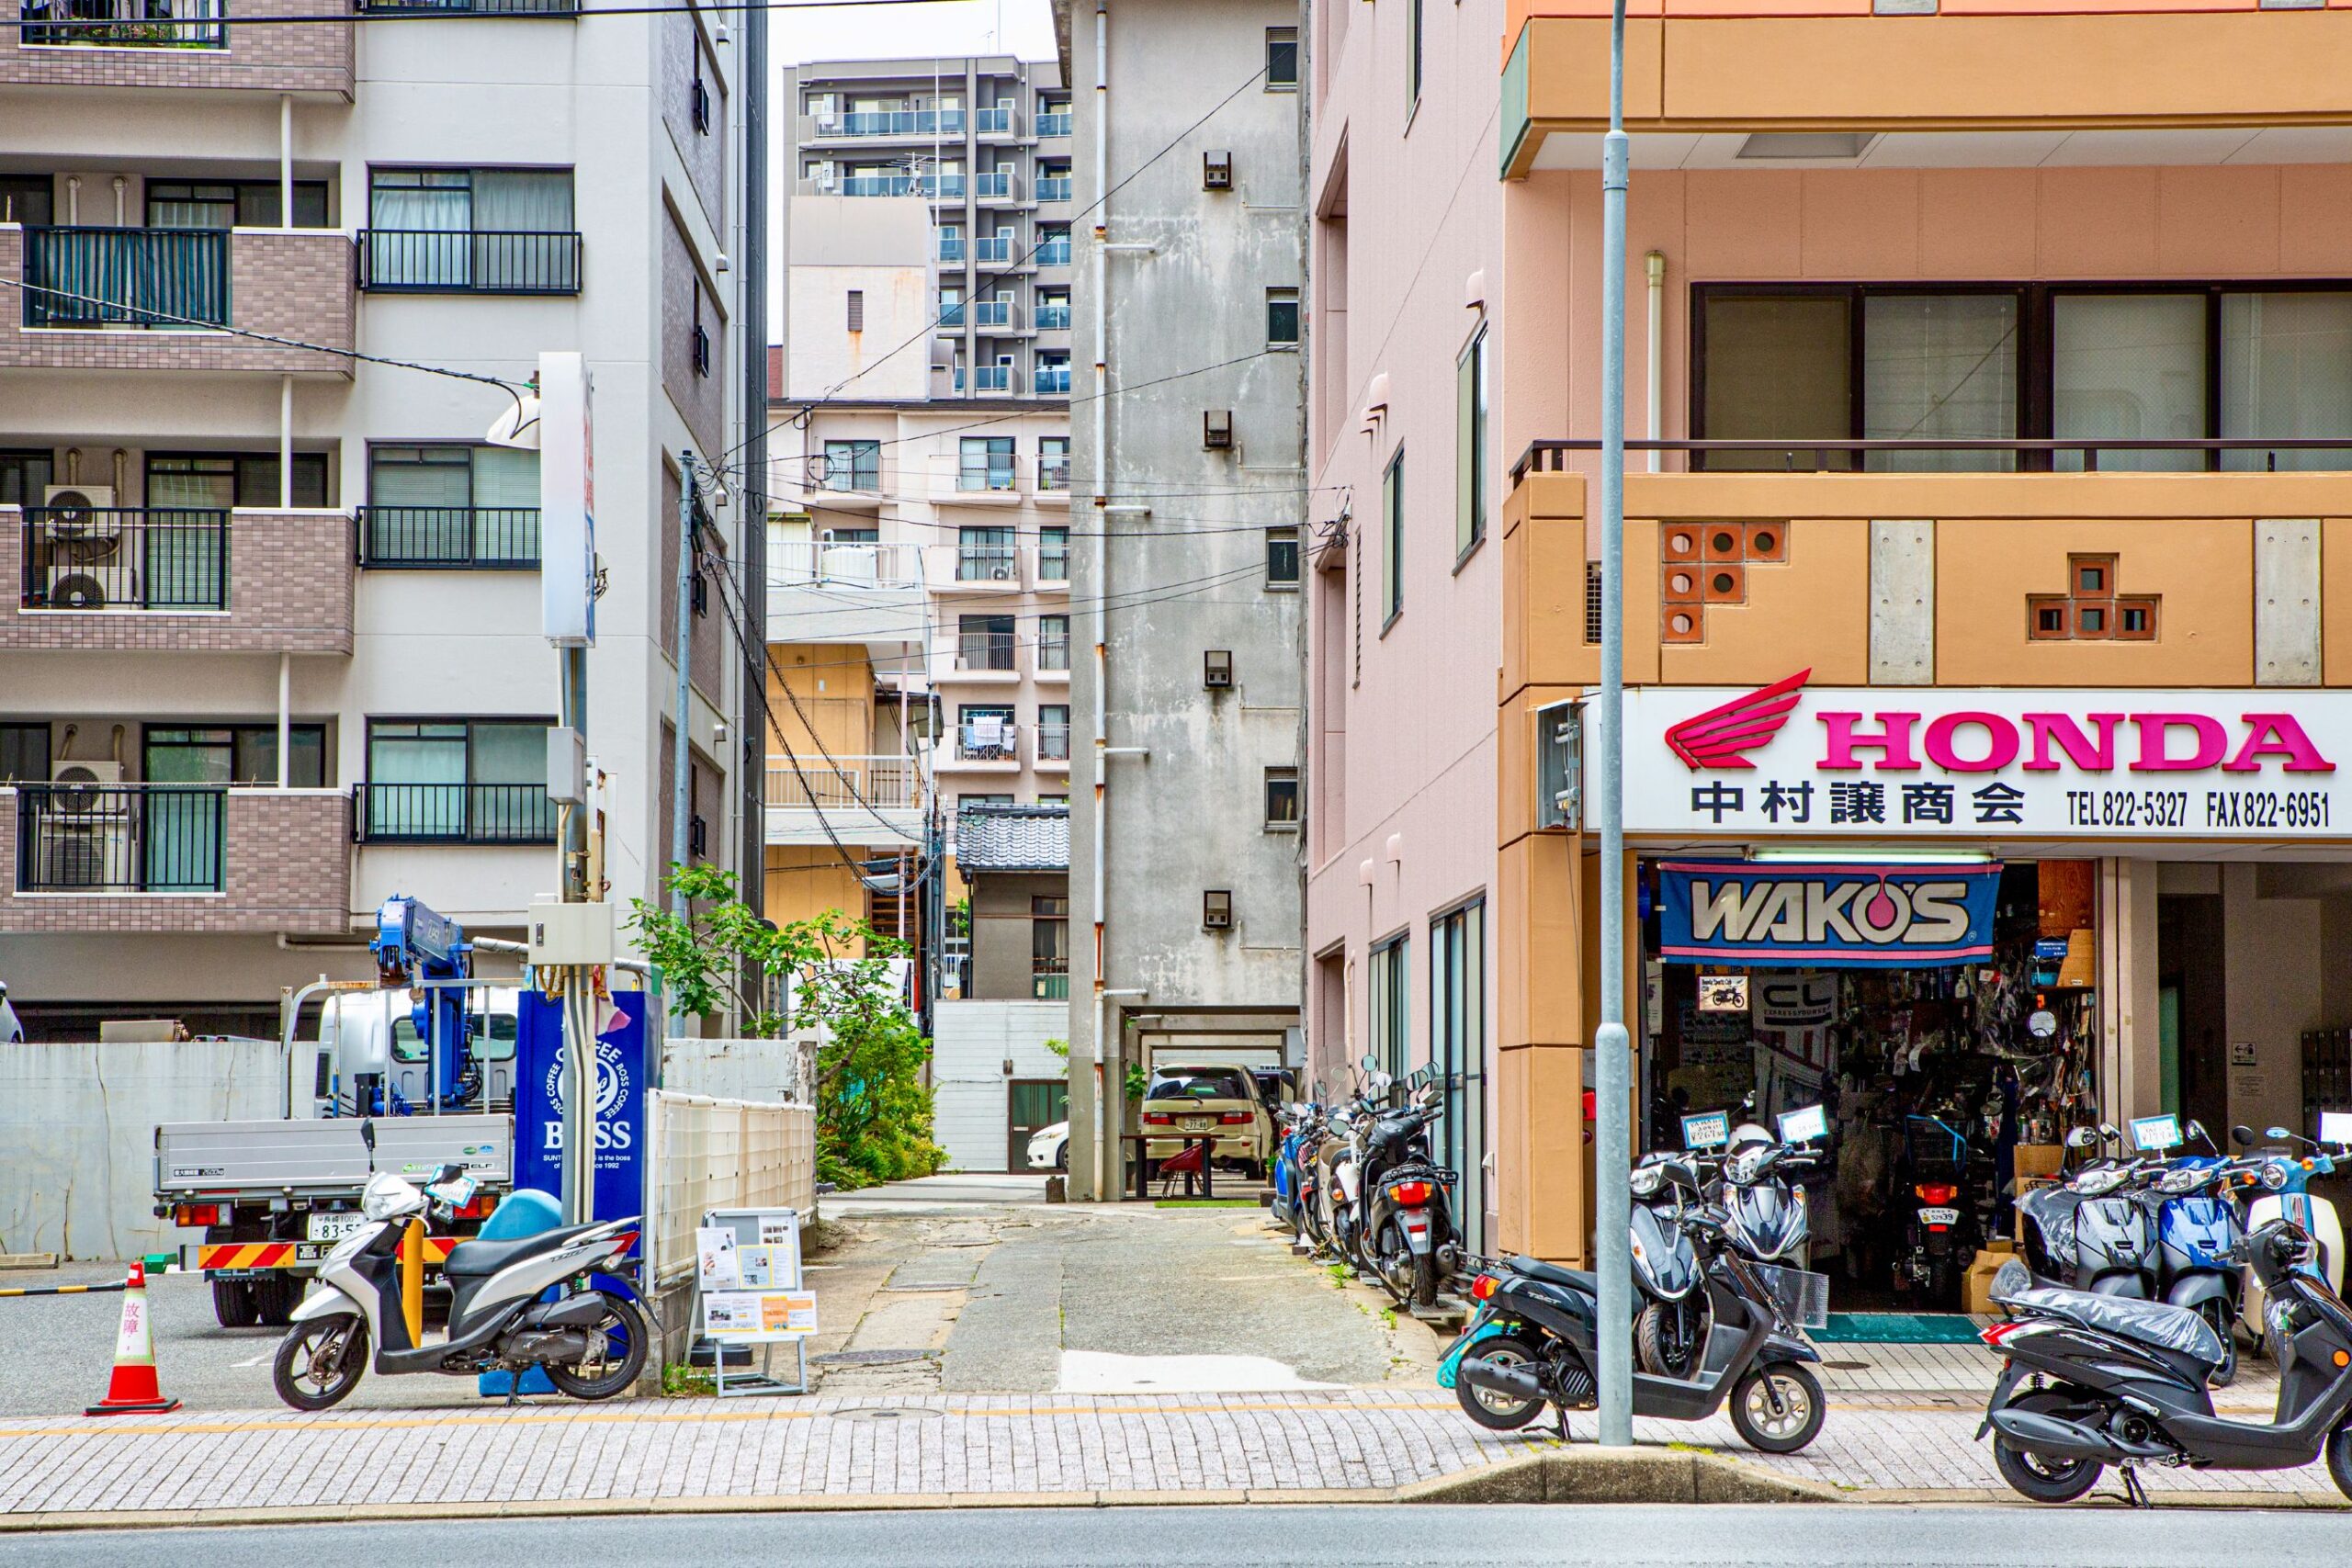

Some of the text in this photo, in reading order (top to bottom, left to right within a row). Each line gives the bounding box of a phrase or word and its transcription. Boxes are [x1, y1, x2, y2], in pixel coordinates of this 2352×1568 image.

[1815, 711, 2337, 772] HONDA
[1690, 780, 2026, 825] 中村譲商会
[1691, 881, 1970, 943] WAKO'S
[546, 1063, 561, 1098] COFFEE
[604, 1062, 630, 1120] BOSS COFFEE
[543, 1120, 631, 1149] BSS
[322, 1224, 360, 1239] 83-5
